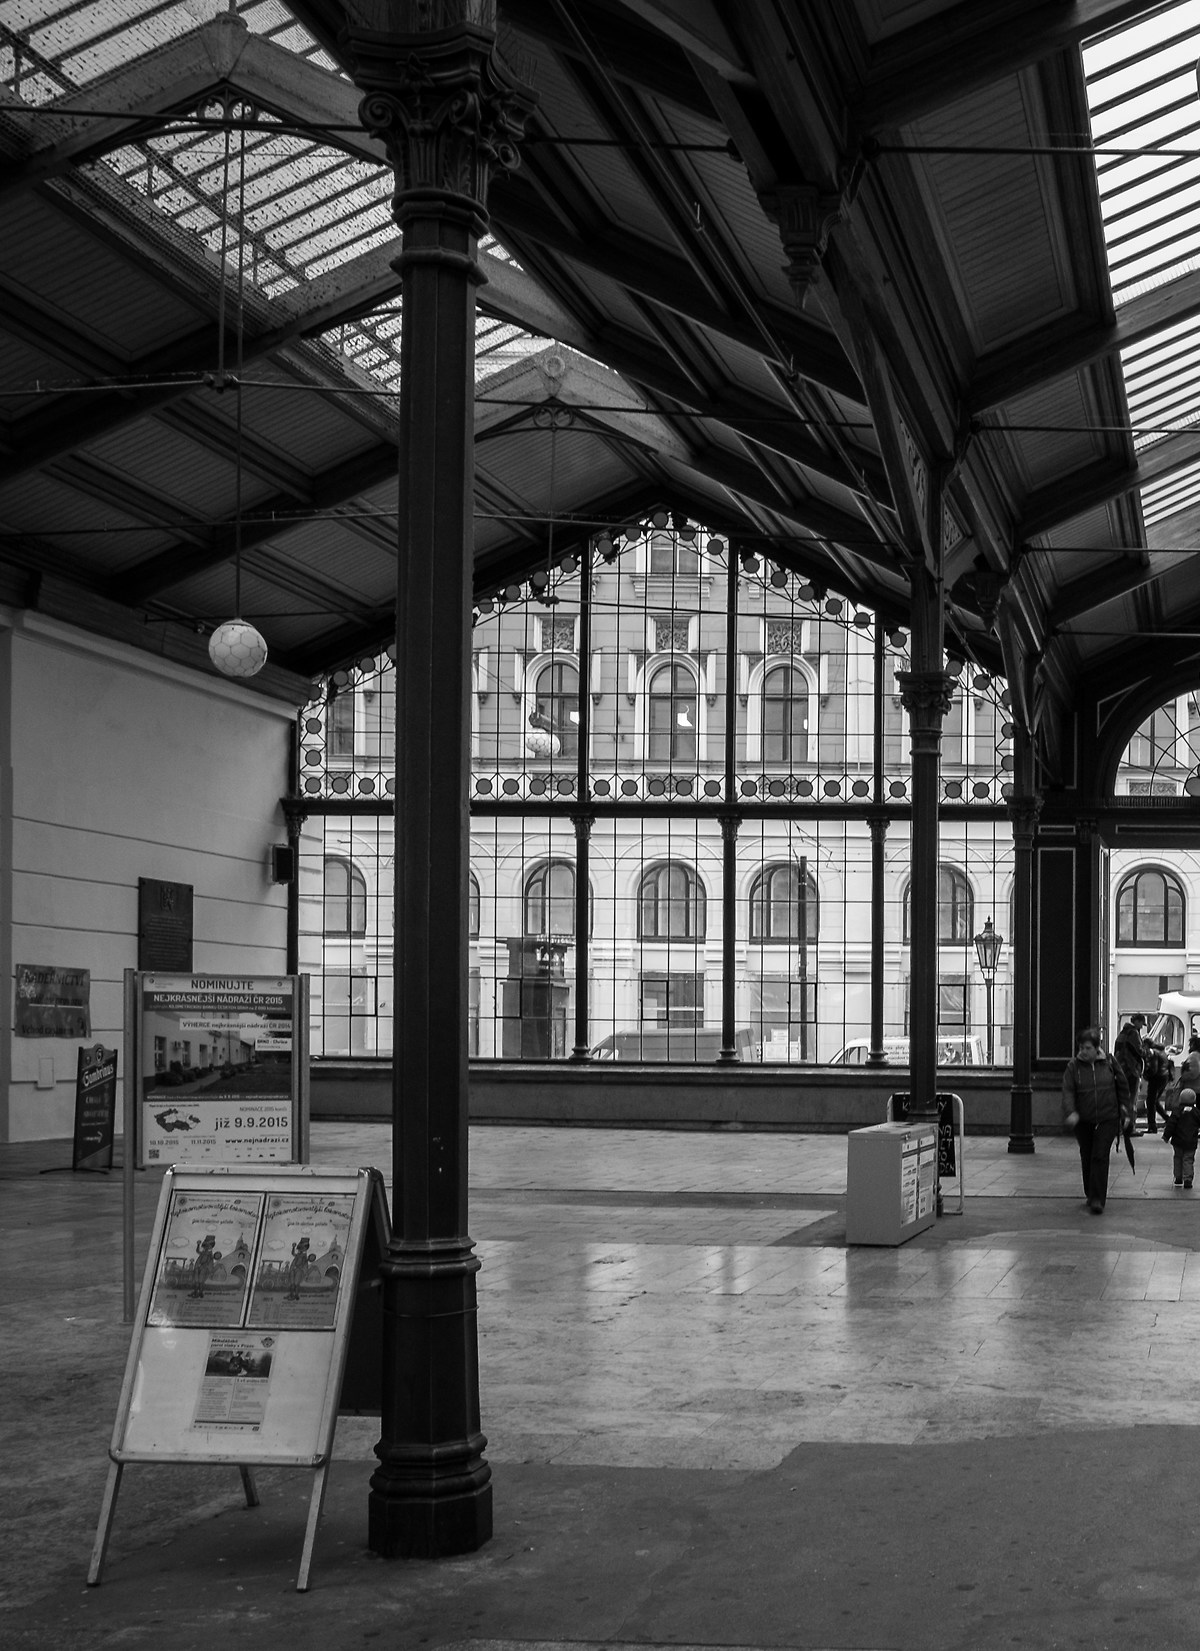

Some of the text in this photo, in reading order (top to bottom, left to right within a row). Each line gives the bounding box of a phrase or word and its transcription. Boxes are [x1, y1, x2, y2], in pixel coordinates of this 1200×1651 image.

[191, 979, 254, 990] NOMINUJTE
[153, 993, 283, 1004] NEJKRÁSNĚJŠÍ NÁDRAŽÍ ČR 2015
[214, 1117, 288, 1131] již 9.9.2015
